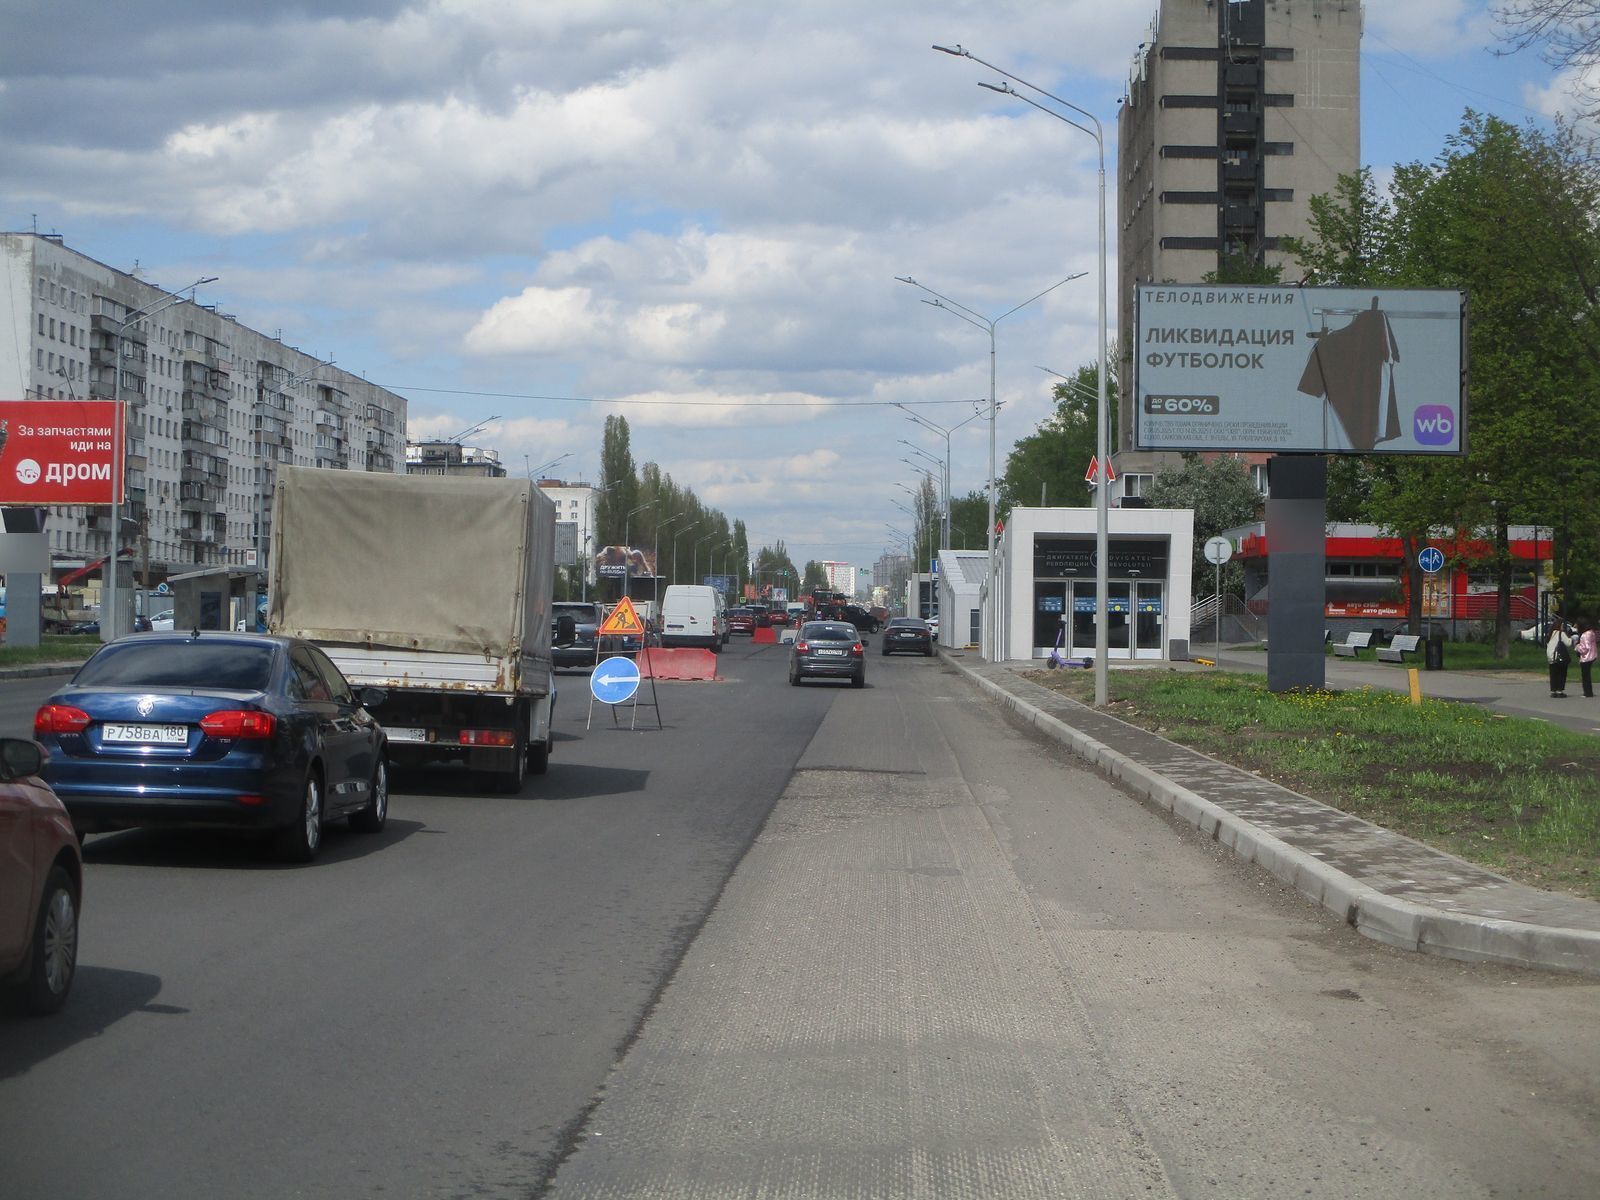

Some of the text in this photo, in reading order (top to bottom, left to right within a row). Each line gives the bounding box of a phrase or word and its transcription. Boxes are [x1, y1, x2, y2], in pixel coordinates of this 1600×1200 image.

[1144, 291, 1295, 305] ТЕЛОДВИЖЕНИЯ
[1145, 328, 1295, 347] ЛИКВИДАЦИЯ
[1145, 352, 1265, 369] ФУТБОЛОК
[18, 425, 111, 436] За запчастями
[1416, 413, 1452, 434] wb
[70, 441, 111, 452] иди на
[45, 462, 111, 487] дром
[163, 726, 184, 737] 180
